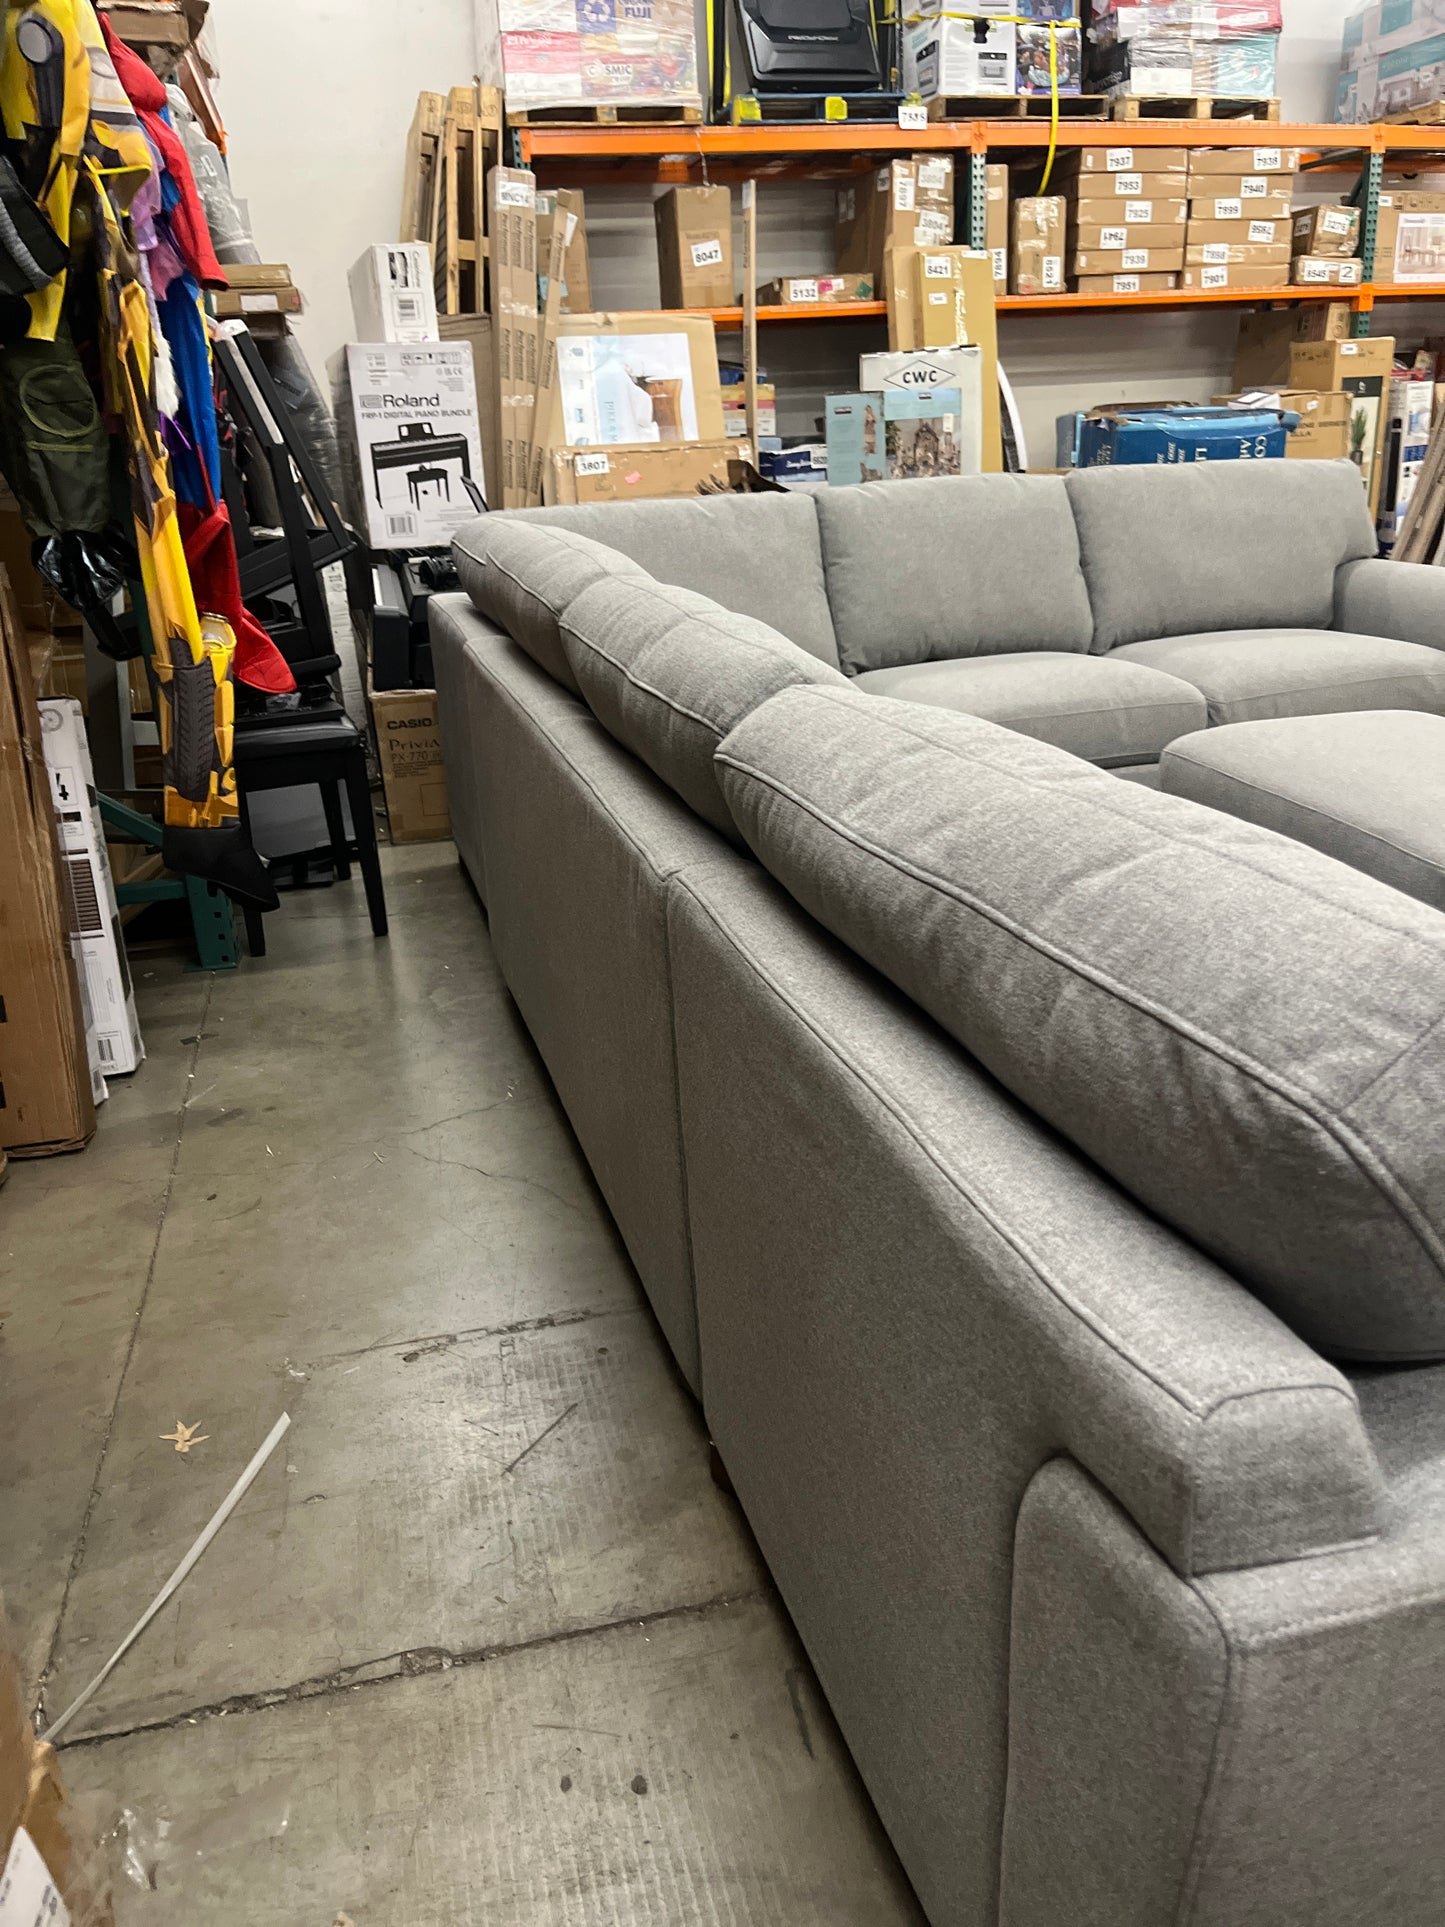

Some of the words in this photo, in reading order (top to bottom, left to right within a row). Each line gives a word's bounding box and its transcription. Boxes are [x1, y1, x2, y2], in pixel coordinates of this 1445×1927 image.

[625, 7, 652, 19] FUJI
[1109, 154, 1131, 168] 7937
[899, 180, 908, 207] 7897
[1342, 266, 1353, 278] 2
[792, 288, 816, 298] 5132
[903, 370, 937, 384] CWC
[383, 393, 440, 409] Roland
[384, 411, 414, 419] DIGITAL
[415, 410, 439, 418] PIANO
[441, 408, 473, 417] BUNDLE
[580, 461, 606, 472] 3807
[387, 717, 433, 730] CASIO
